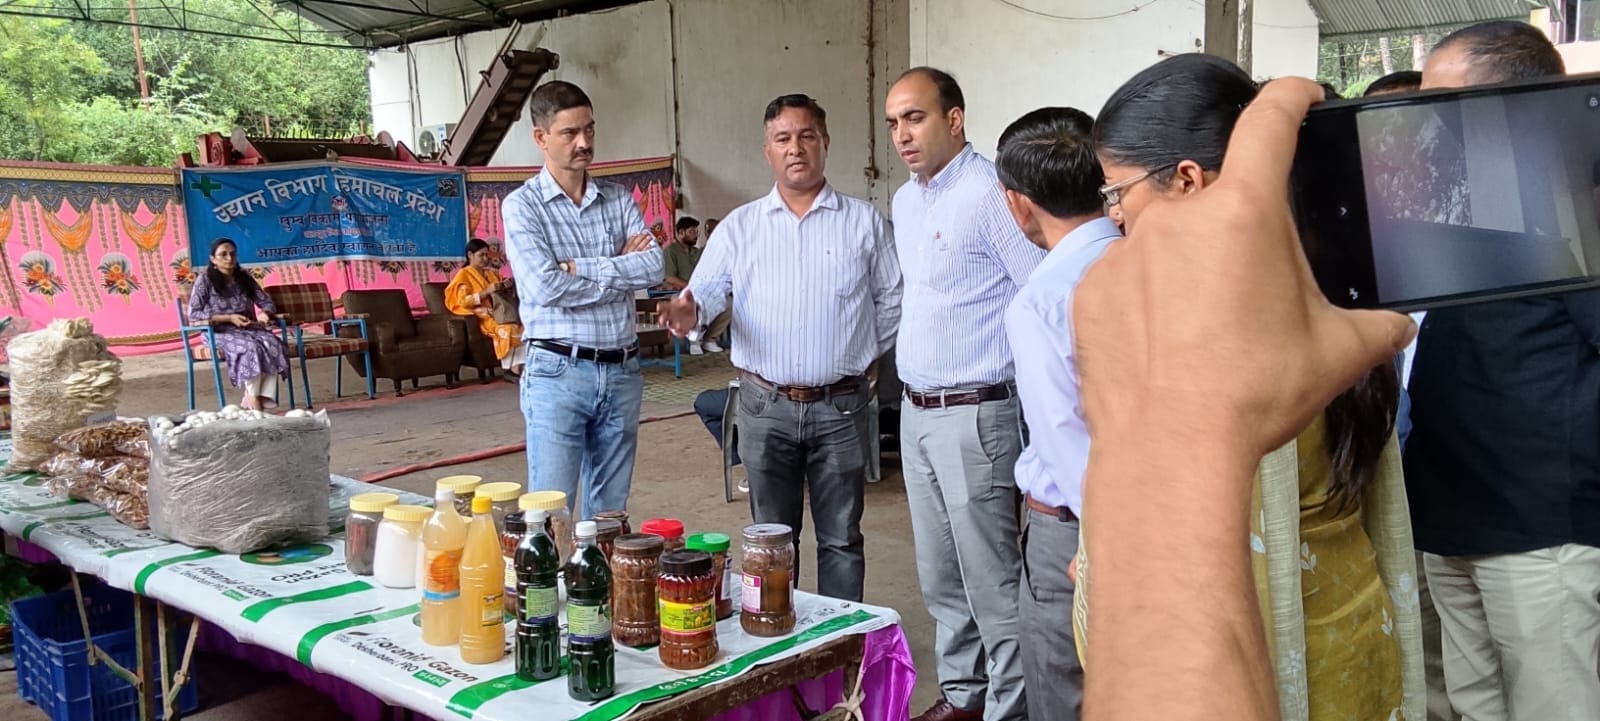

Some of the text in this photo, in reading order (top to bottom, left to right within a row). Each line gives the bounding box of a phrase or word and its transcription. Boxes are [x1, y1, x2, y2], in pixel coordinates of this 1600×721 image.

[212, 168, 445, 224] उद्यान विभाग हिमाचल प्रदेश
[427, 660, 479, 683] Gazon
